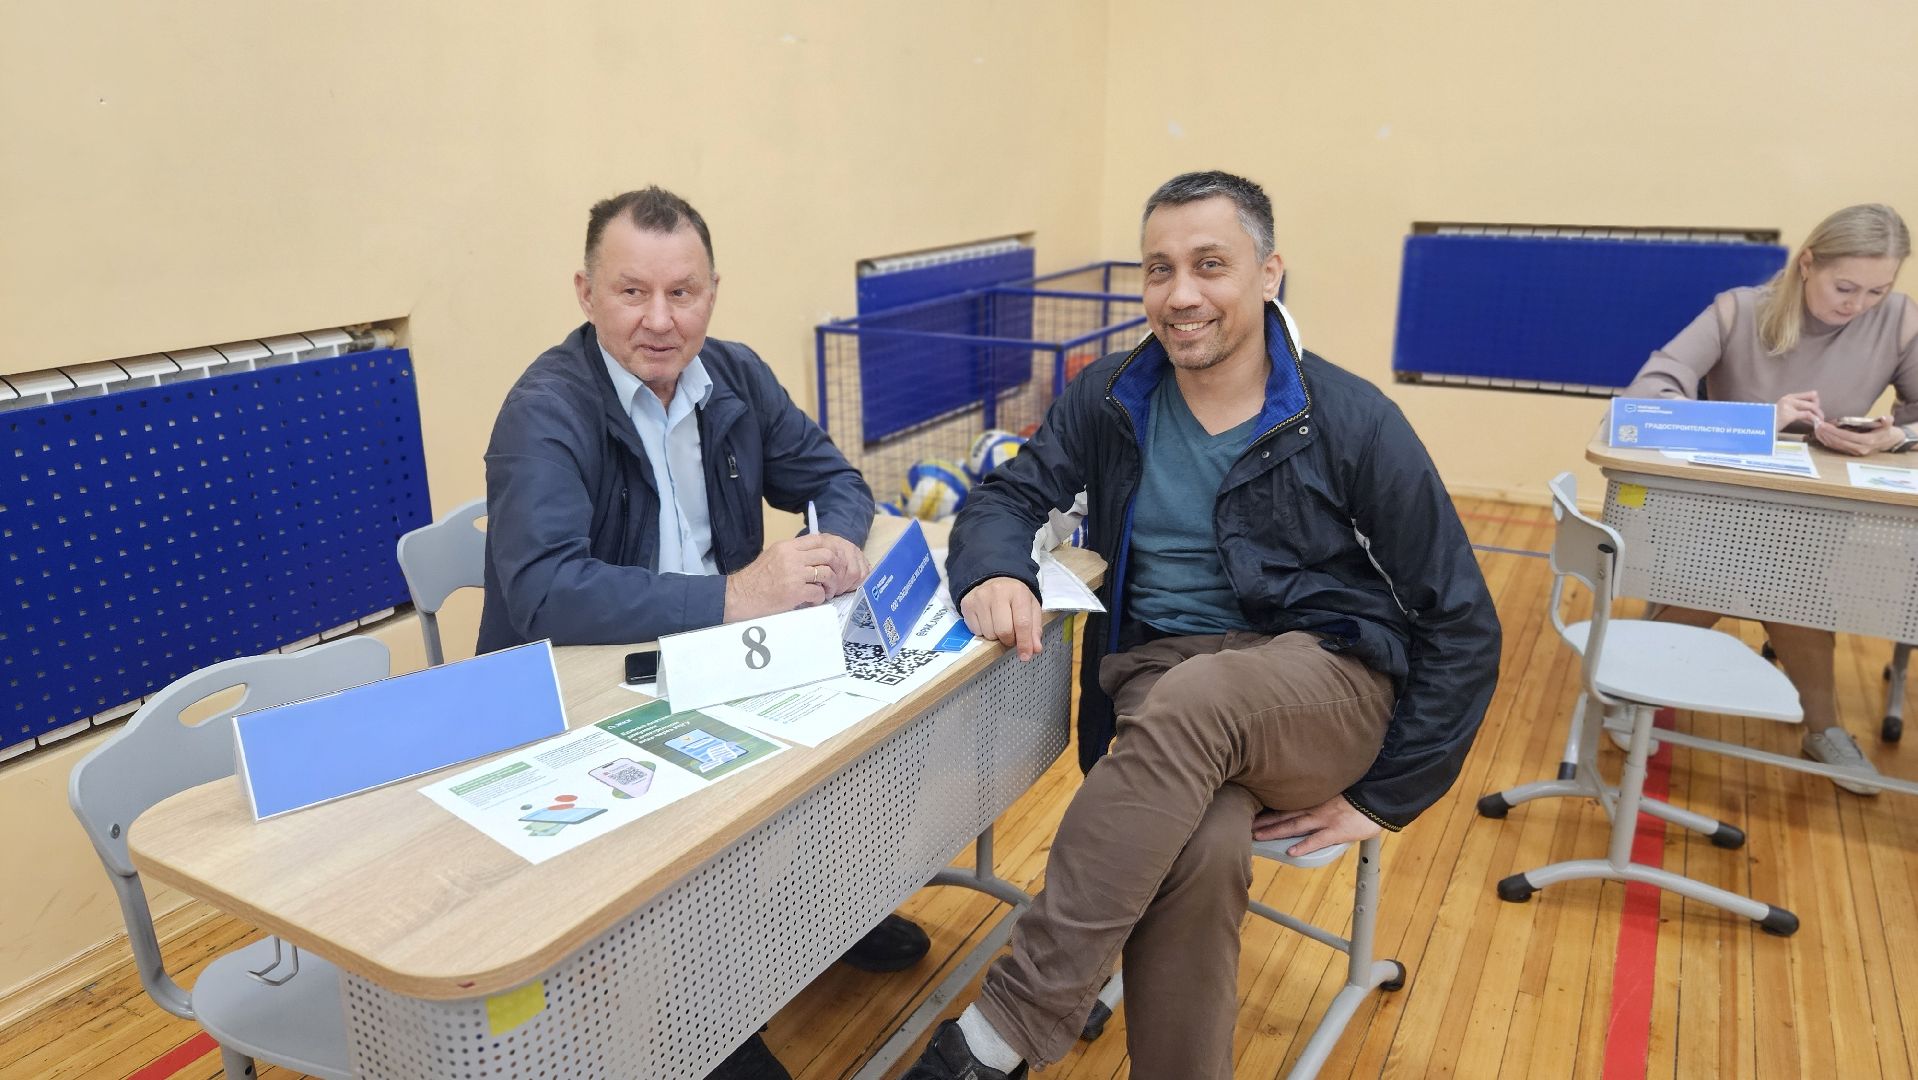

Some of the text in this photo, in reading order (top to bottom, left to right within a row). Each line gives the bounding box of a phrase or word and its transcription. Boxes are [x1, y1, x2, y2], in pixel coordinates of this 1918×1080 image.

[1644, 422, 1725, 433] ГРАДОСТРОИТЕЛЬСТВО
[1732, 428, 1766, 436] РЕКЛАМА
[742, 626, 771, 669] 8
